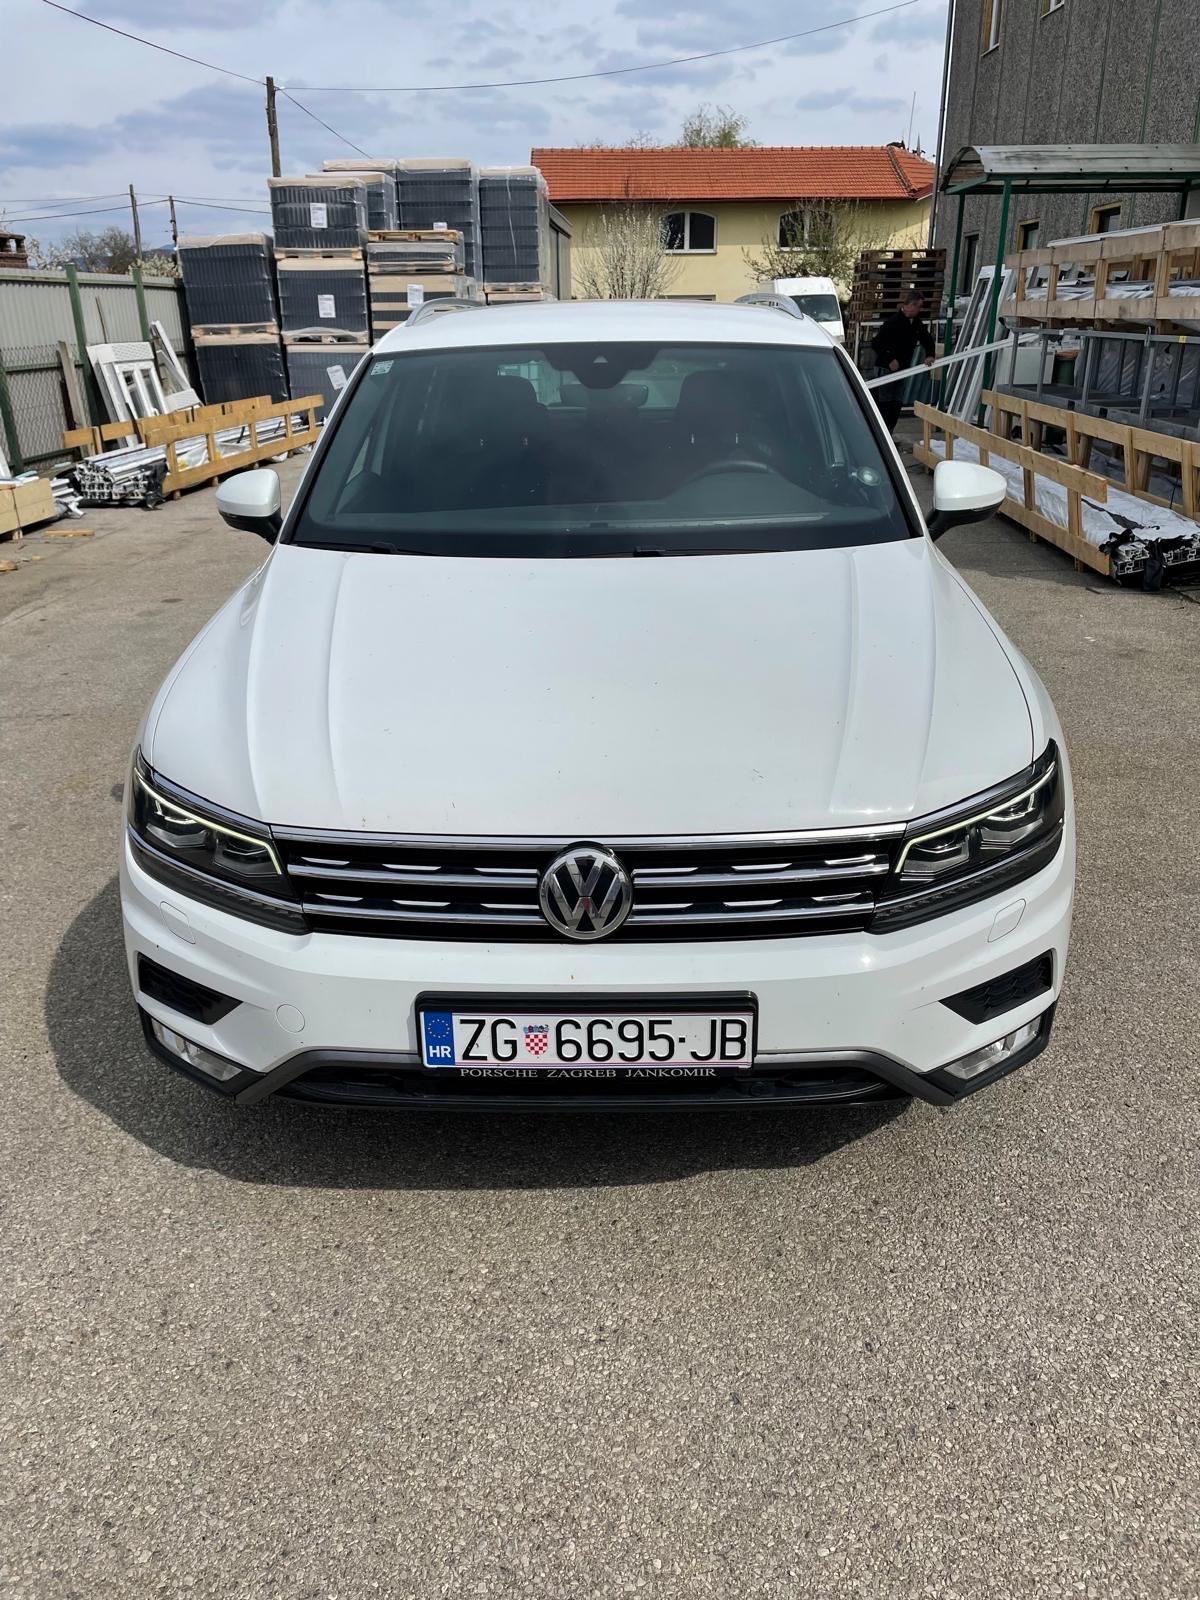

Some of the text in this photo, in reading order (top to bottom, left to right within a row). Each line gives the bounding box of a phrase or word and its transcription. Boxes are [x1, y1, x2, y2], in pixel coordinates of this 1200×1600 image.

[543, 849, 630, 939] VW
[429, 1046, 451, 1058] HR
[460, 1018, 518, 1062] ZG
[460, 1068, 717, 1078] PORSCHE ZAGREB JANKOMIR
